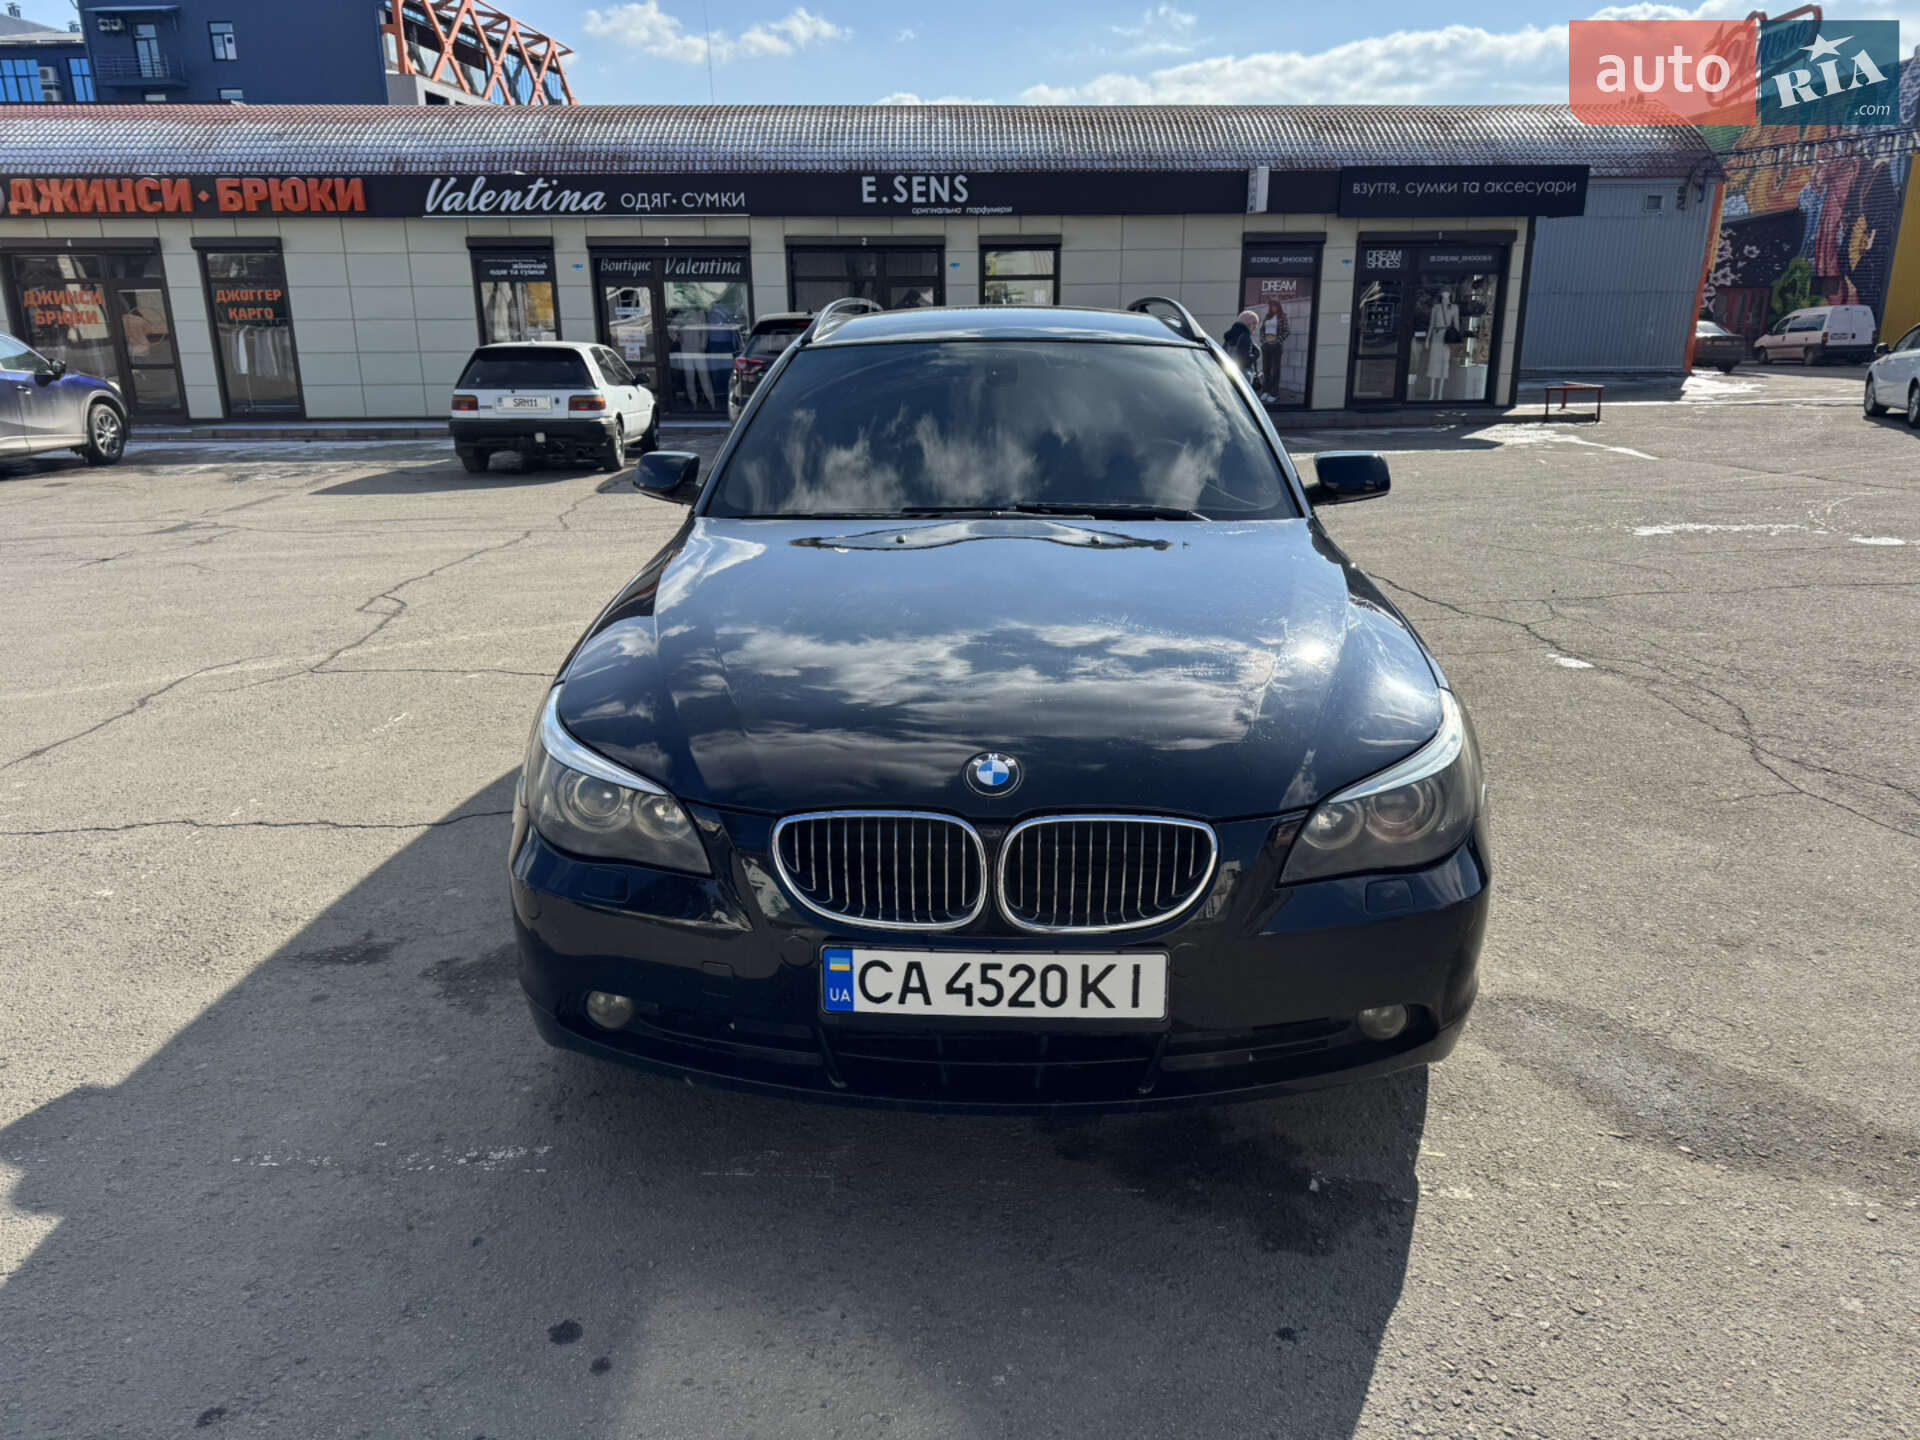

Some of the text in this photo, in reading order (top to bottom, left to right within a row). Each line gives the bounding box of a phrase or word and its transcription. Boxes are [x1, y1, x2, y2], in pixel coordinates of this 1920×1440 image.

[8, 177, 366, 215] ДЖИНСИ БРЮКИ
[425, 175, 606, 213] Valentina
[861, 174, 969, 203] E.SENS
[1352, 180, 1577, 197] взуття, сумки та аксесуари
[620, 192, 746, 211] ОДЯГ СУМКИ
[600, 257, 741, 277] Boutique Valentina
[1262, 280, 1297, 291] DREAM
[24, 290, 103, 307] ДЖИНСИ
[216, 289, 282, 303] ДЖОГГЕР
[34, 311, 98, 326] БРЮКИ
[228, 308, 275, 320] КАРГО
[858, 960, 1141, 1008] CA 4520 KI
[829, 987, 851, 1002] UA
